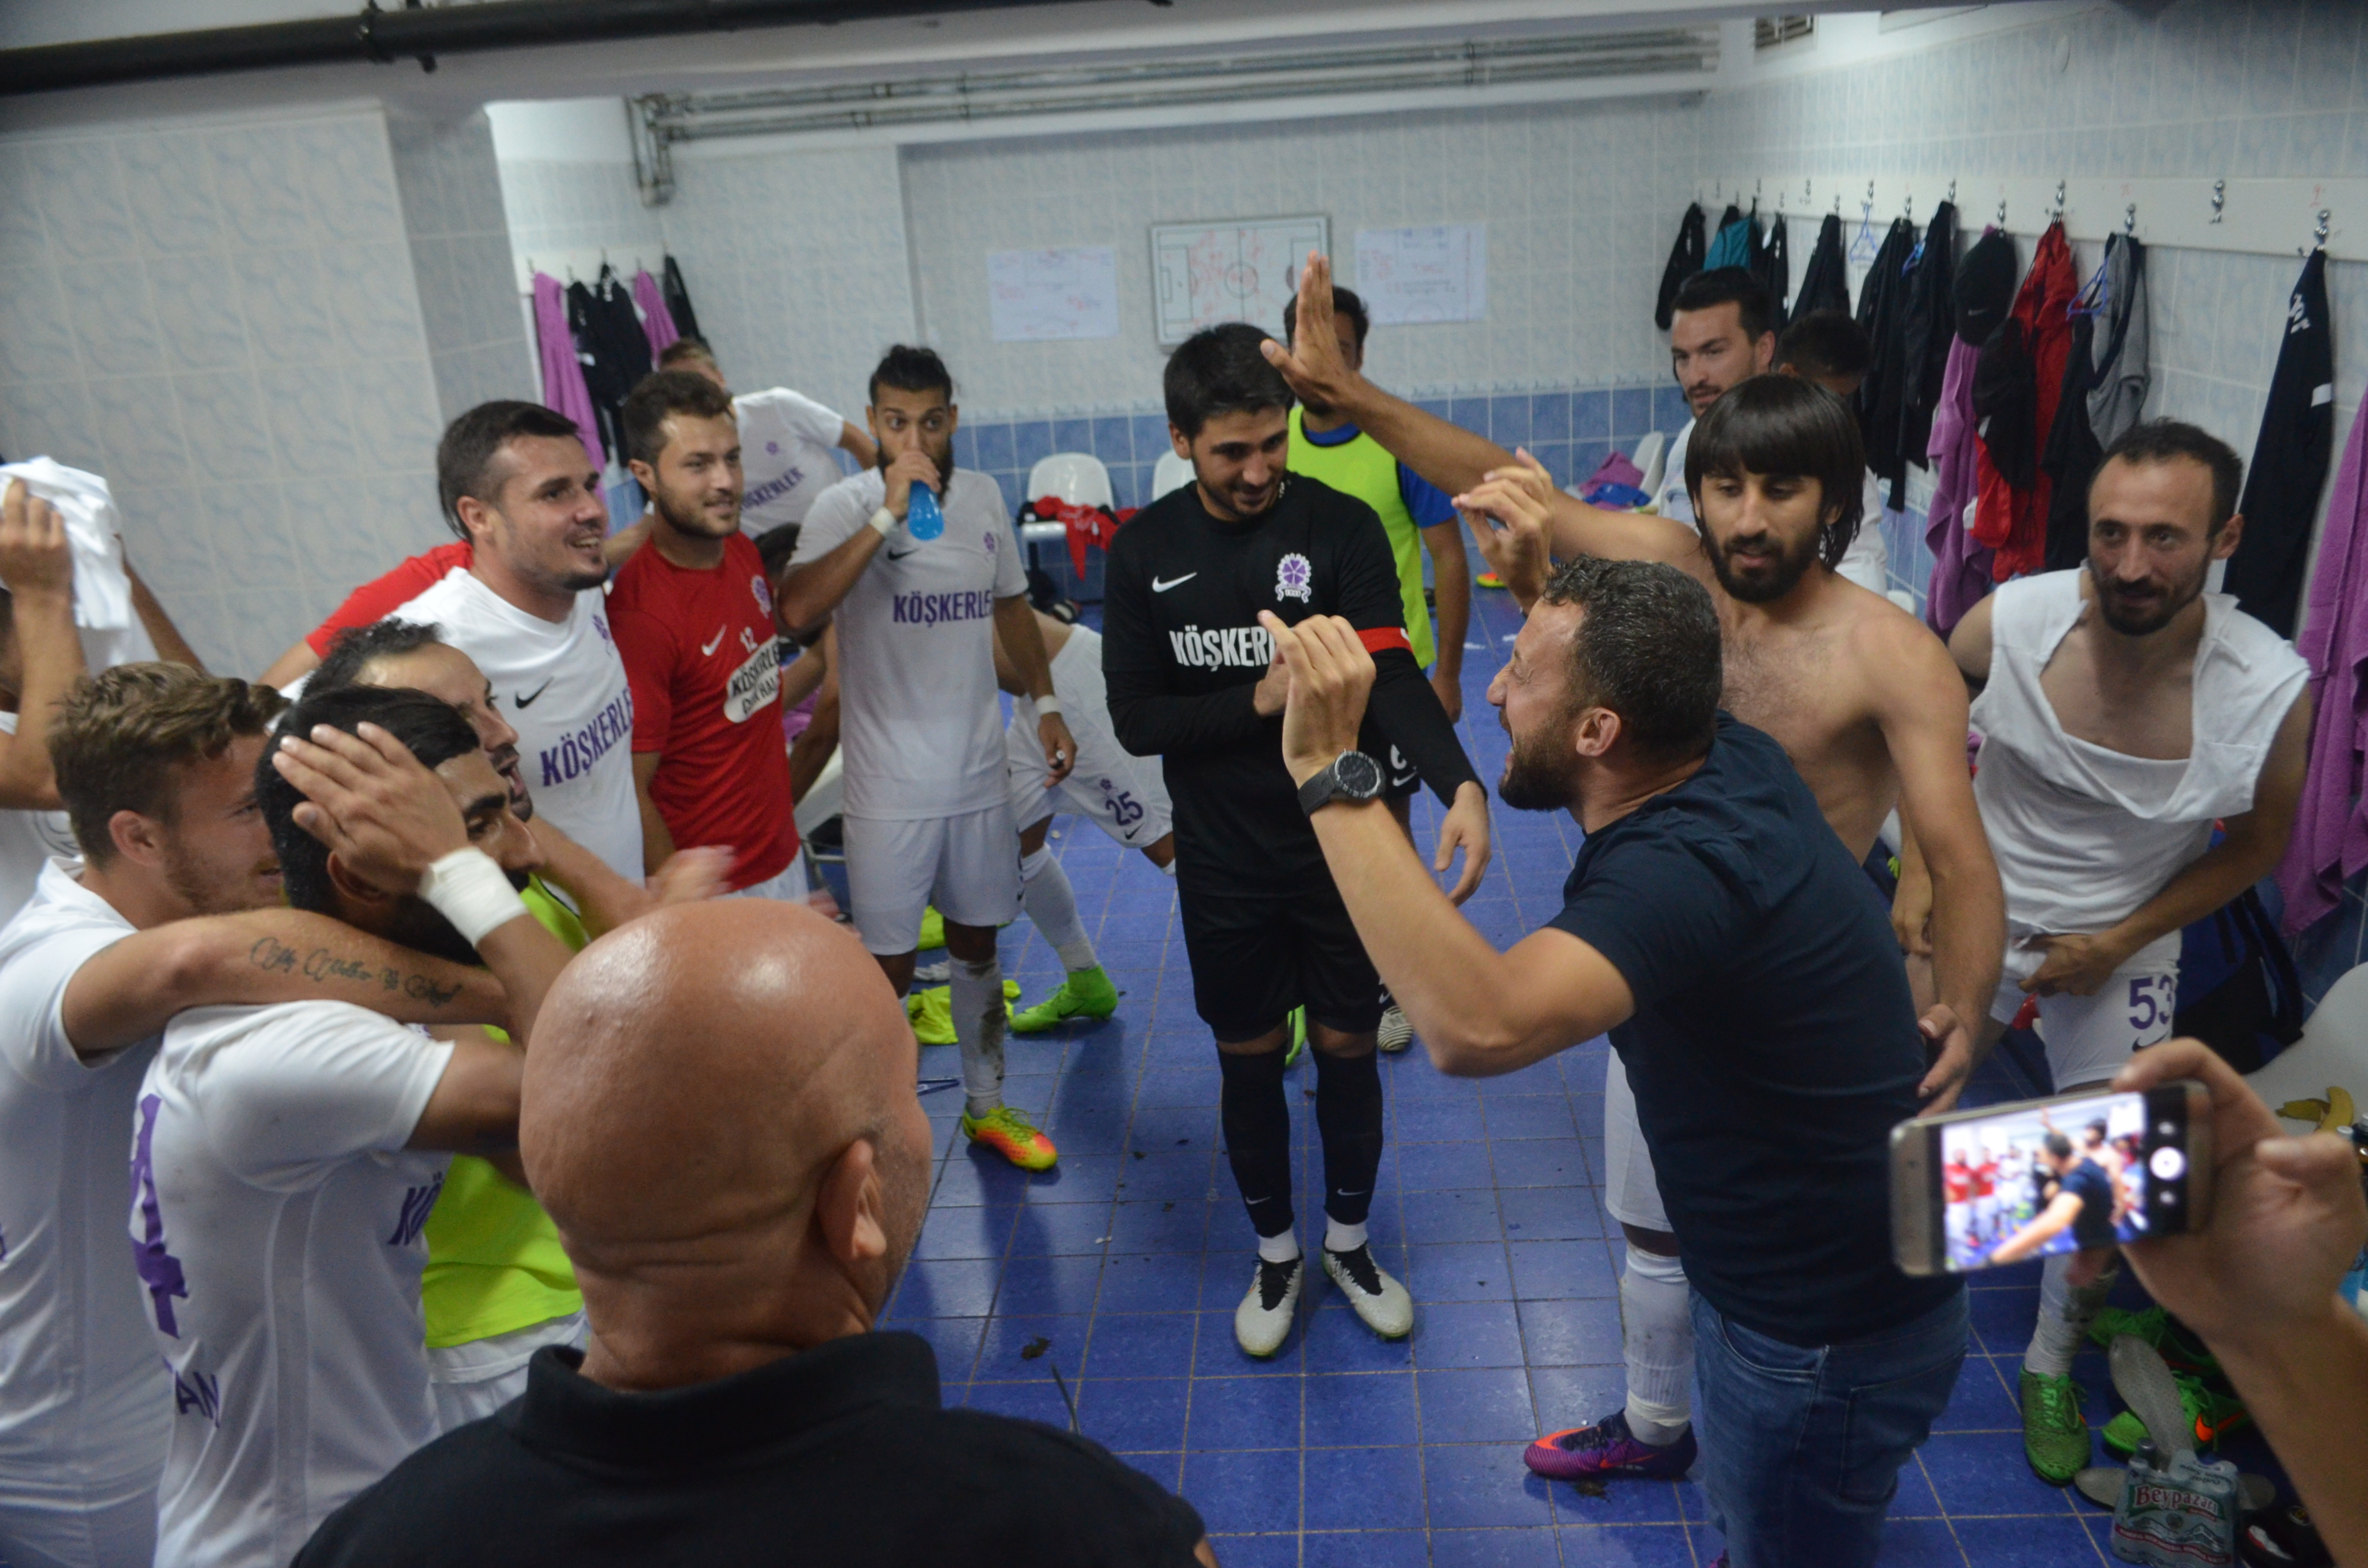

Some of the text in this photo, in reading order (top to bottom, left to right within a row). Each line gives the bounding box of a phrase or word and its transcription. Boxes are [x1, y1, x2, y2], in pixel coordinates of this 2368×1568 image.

[1105, 790, 1144, 826] 25
[2128, 974, 2174, 1030] 53
[162, 1355, 220, 1428] AN
